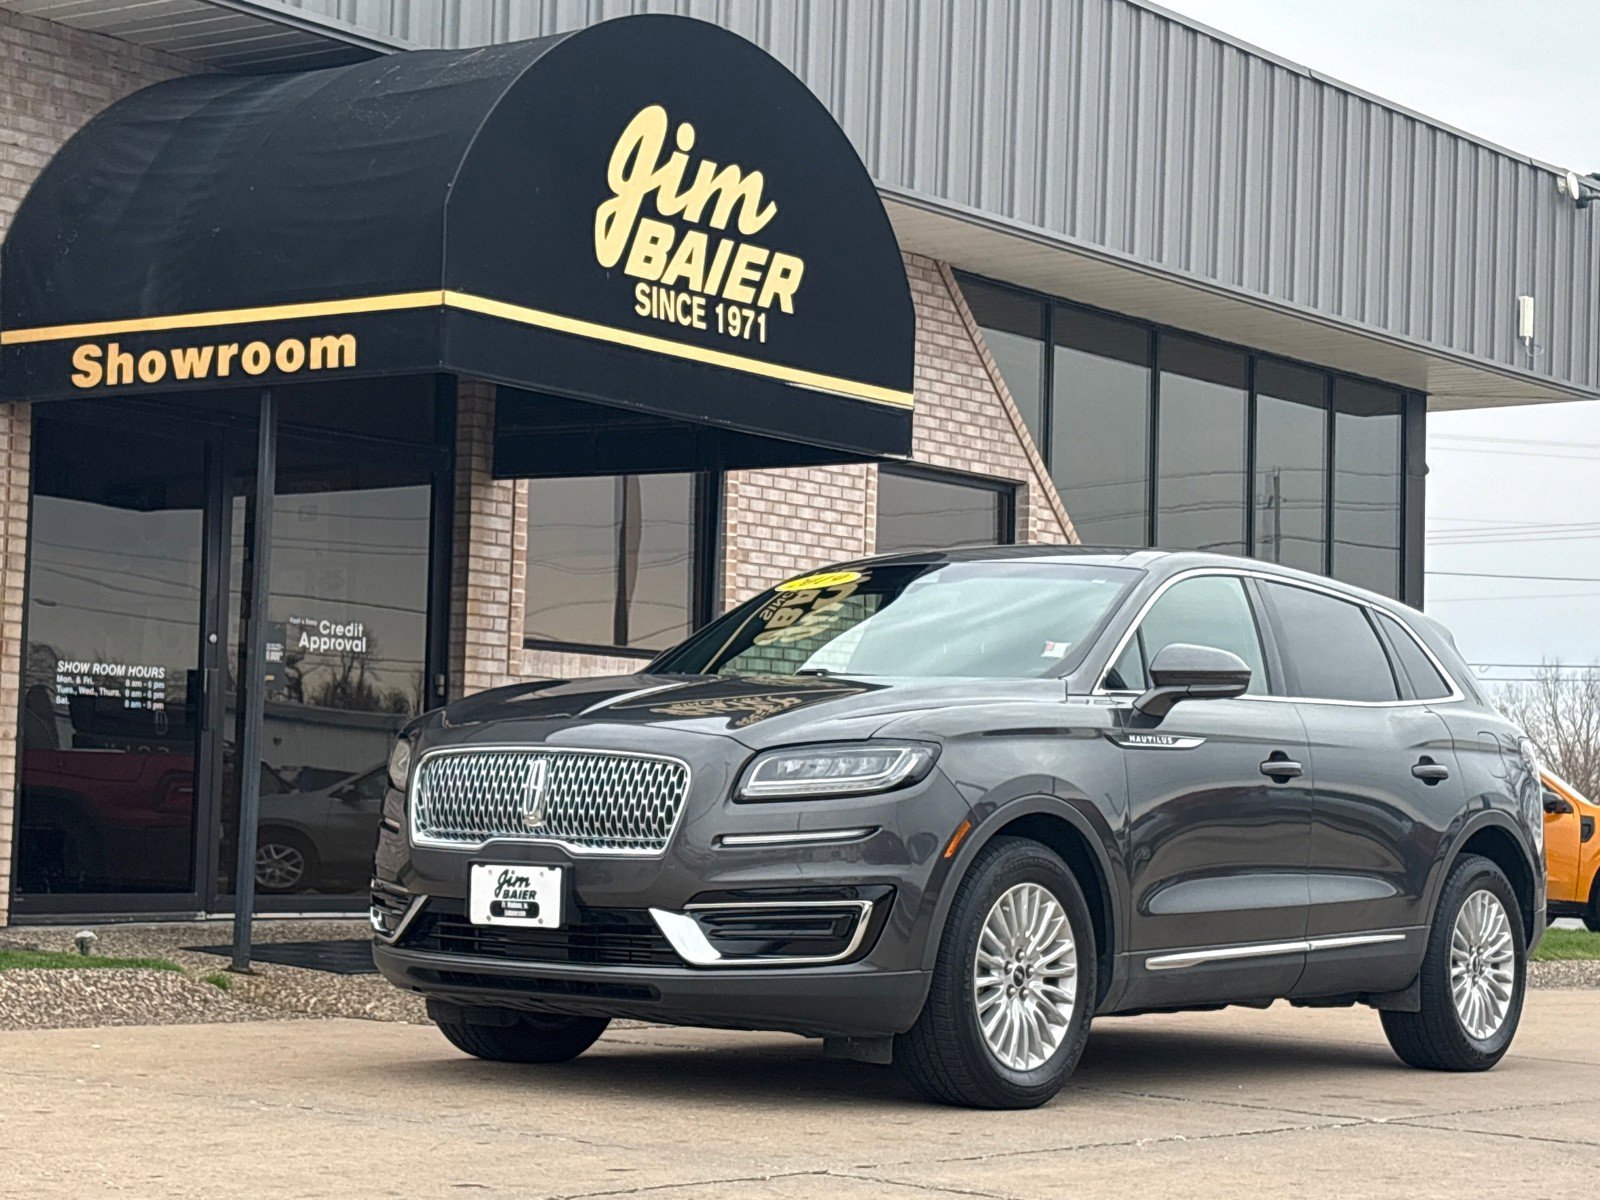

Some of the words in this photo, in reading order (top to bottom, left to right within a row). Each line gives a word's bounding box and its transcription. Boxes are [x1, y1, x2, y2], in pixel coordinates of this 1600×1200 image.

[594, 104, 778, 268] Jim
[624, 217, 804, 314] BAIER
[634, 282, 707, 330] SINCE
[715, 303, 766, 344] 1971
[71, 333, 357, 389] Showroom
[320, 620, 364, 638] Credit
[299, 631, 366, 652] Approval
[58, 660, 90, 674] SHOW
[92, 662, 126, 676] ROOM
[128, 666, 165, 679] HOURS
[56, 674, 74, 684] Mon.
[83, 676, 94, 685] Fri.
[153, 681, 165, 689] pm
[131, 690, 142, 698] am
[153, 691, 165, 700] pm
[153, 702, 164, 711] pm
[1129, 735, 1173, 744] NAUTILUS
[494, 869, 531, 898] Jim
[502, 889, 537, 900] BAIER
